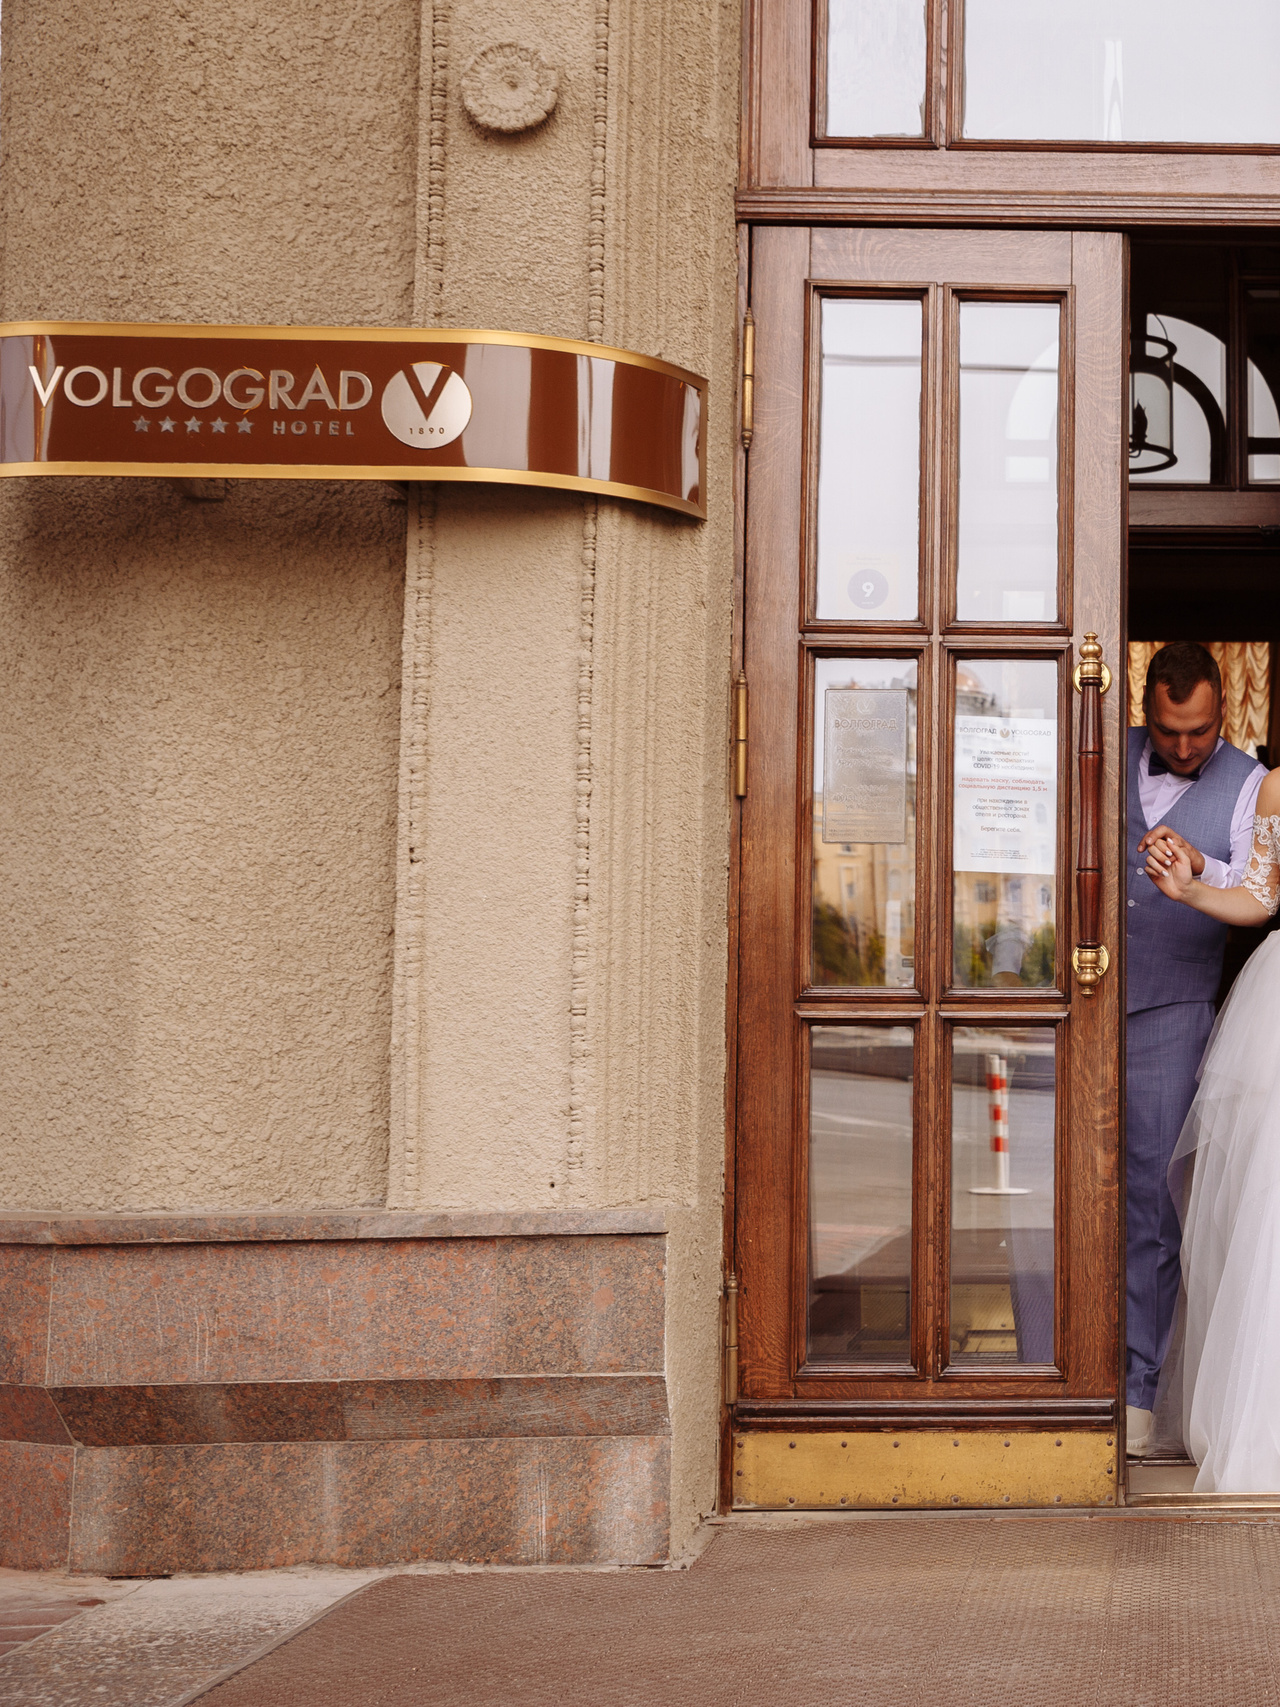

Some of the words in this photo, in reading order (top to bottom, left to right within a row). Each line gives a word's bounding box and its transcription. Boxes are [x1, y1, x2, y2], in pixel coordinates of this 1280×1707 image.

[29, 364, 372, 410] VOLGOGRAD
[273, 420, 355, 436] HOTEL
[409, 427, 445, 435] 1890
[834, 718, 897, 729] ВОЛГОГРАД
